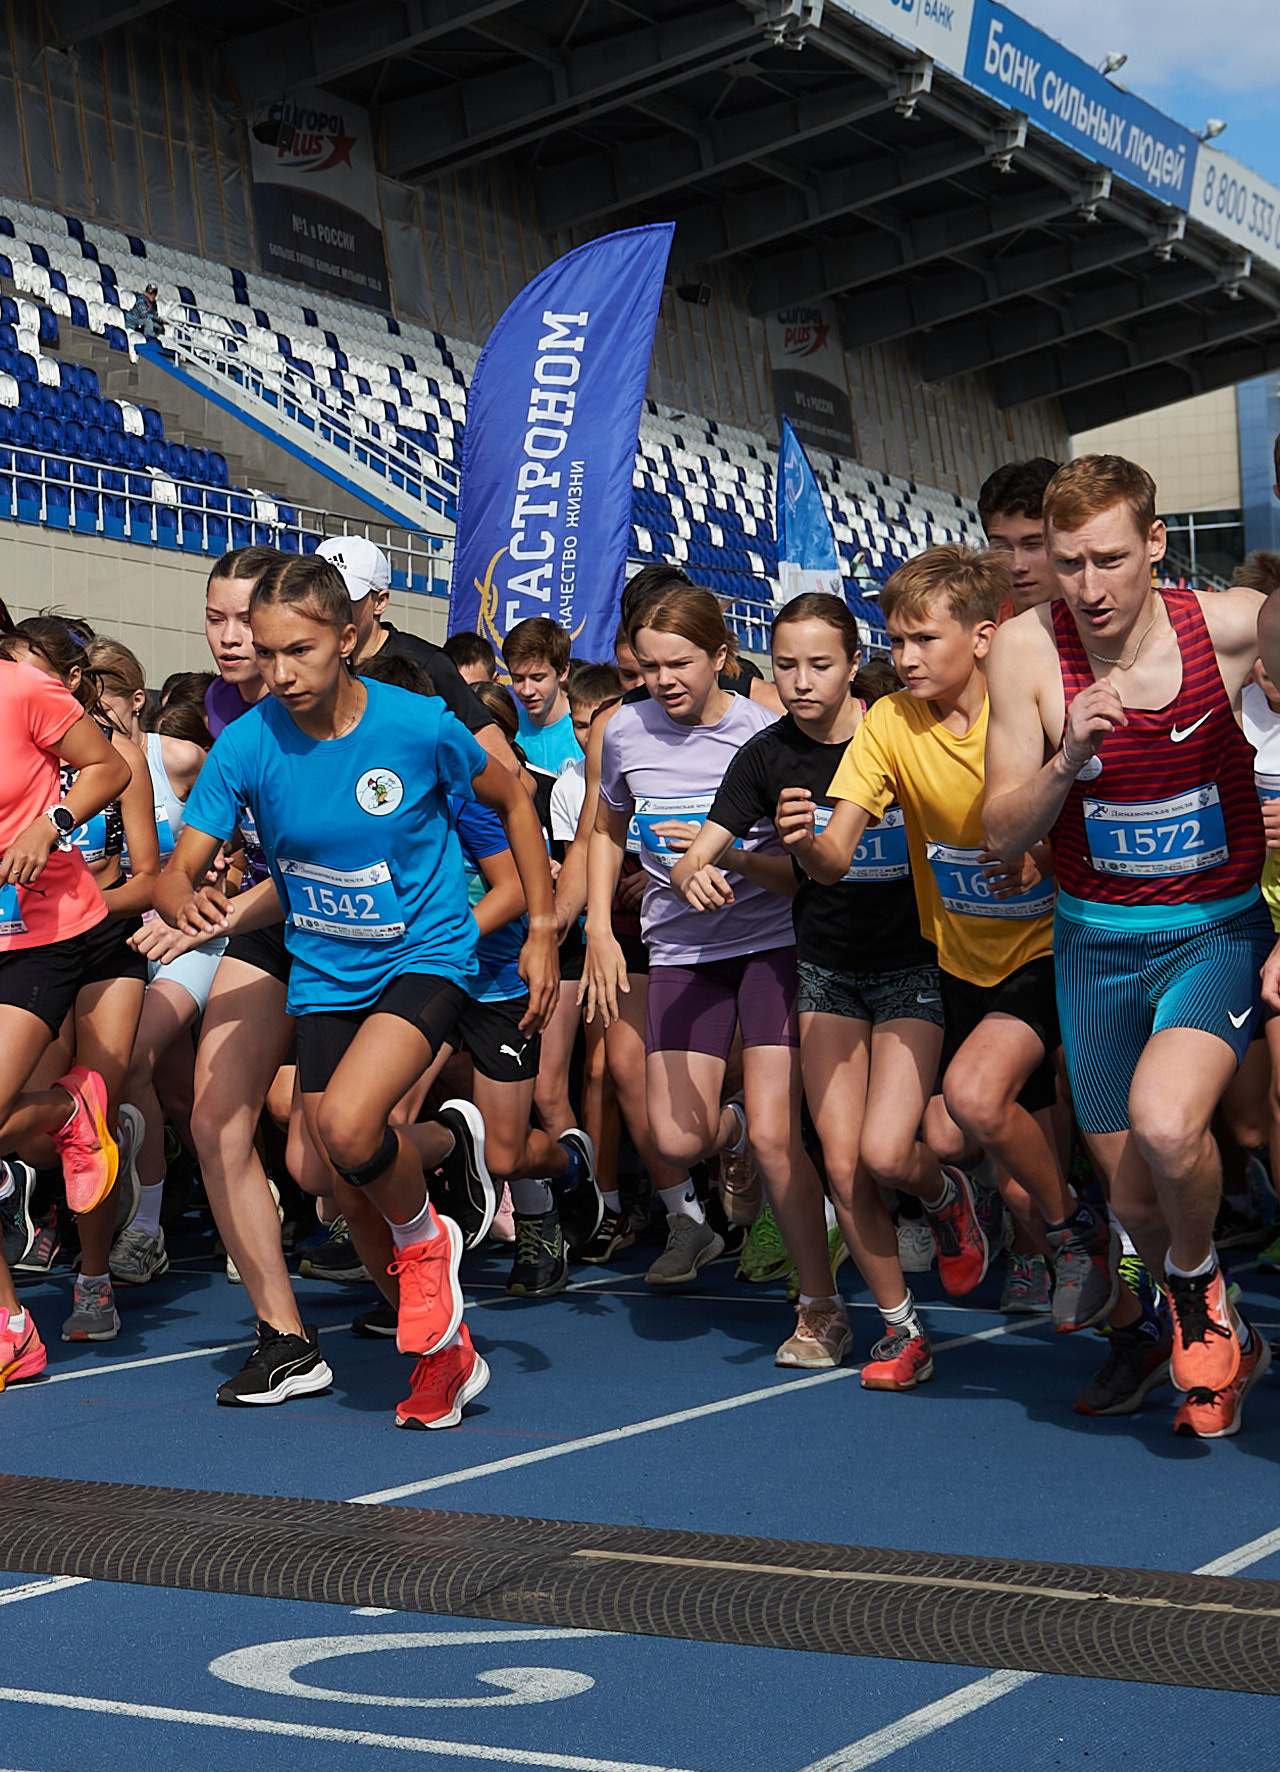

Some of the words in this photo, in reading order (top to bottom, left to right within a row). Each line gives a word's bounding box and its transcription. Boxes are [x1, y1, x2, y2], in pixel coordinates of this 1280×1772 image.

[984, 18, 1041, 100] Банк
[1041, 70, 1126, 155] сильных
[1124, 125, 1187, 191] людей
[1204, 165, 1216, 207] 8
[1216, 173, 1247, 225] 800
[1248, 193, 1274, 242] 333
[317, 223, 356, 253] РОССИИ
[566, 461, 585, 528] ЖИЗНИ
[558, 536, 578, 629] КАЧЕСТВО
[1109, 819, 1205, 855] 1572
[302, 885, 380, 920] 1542
